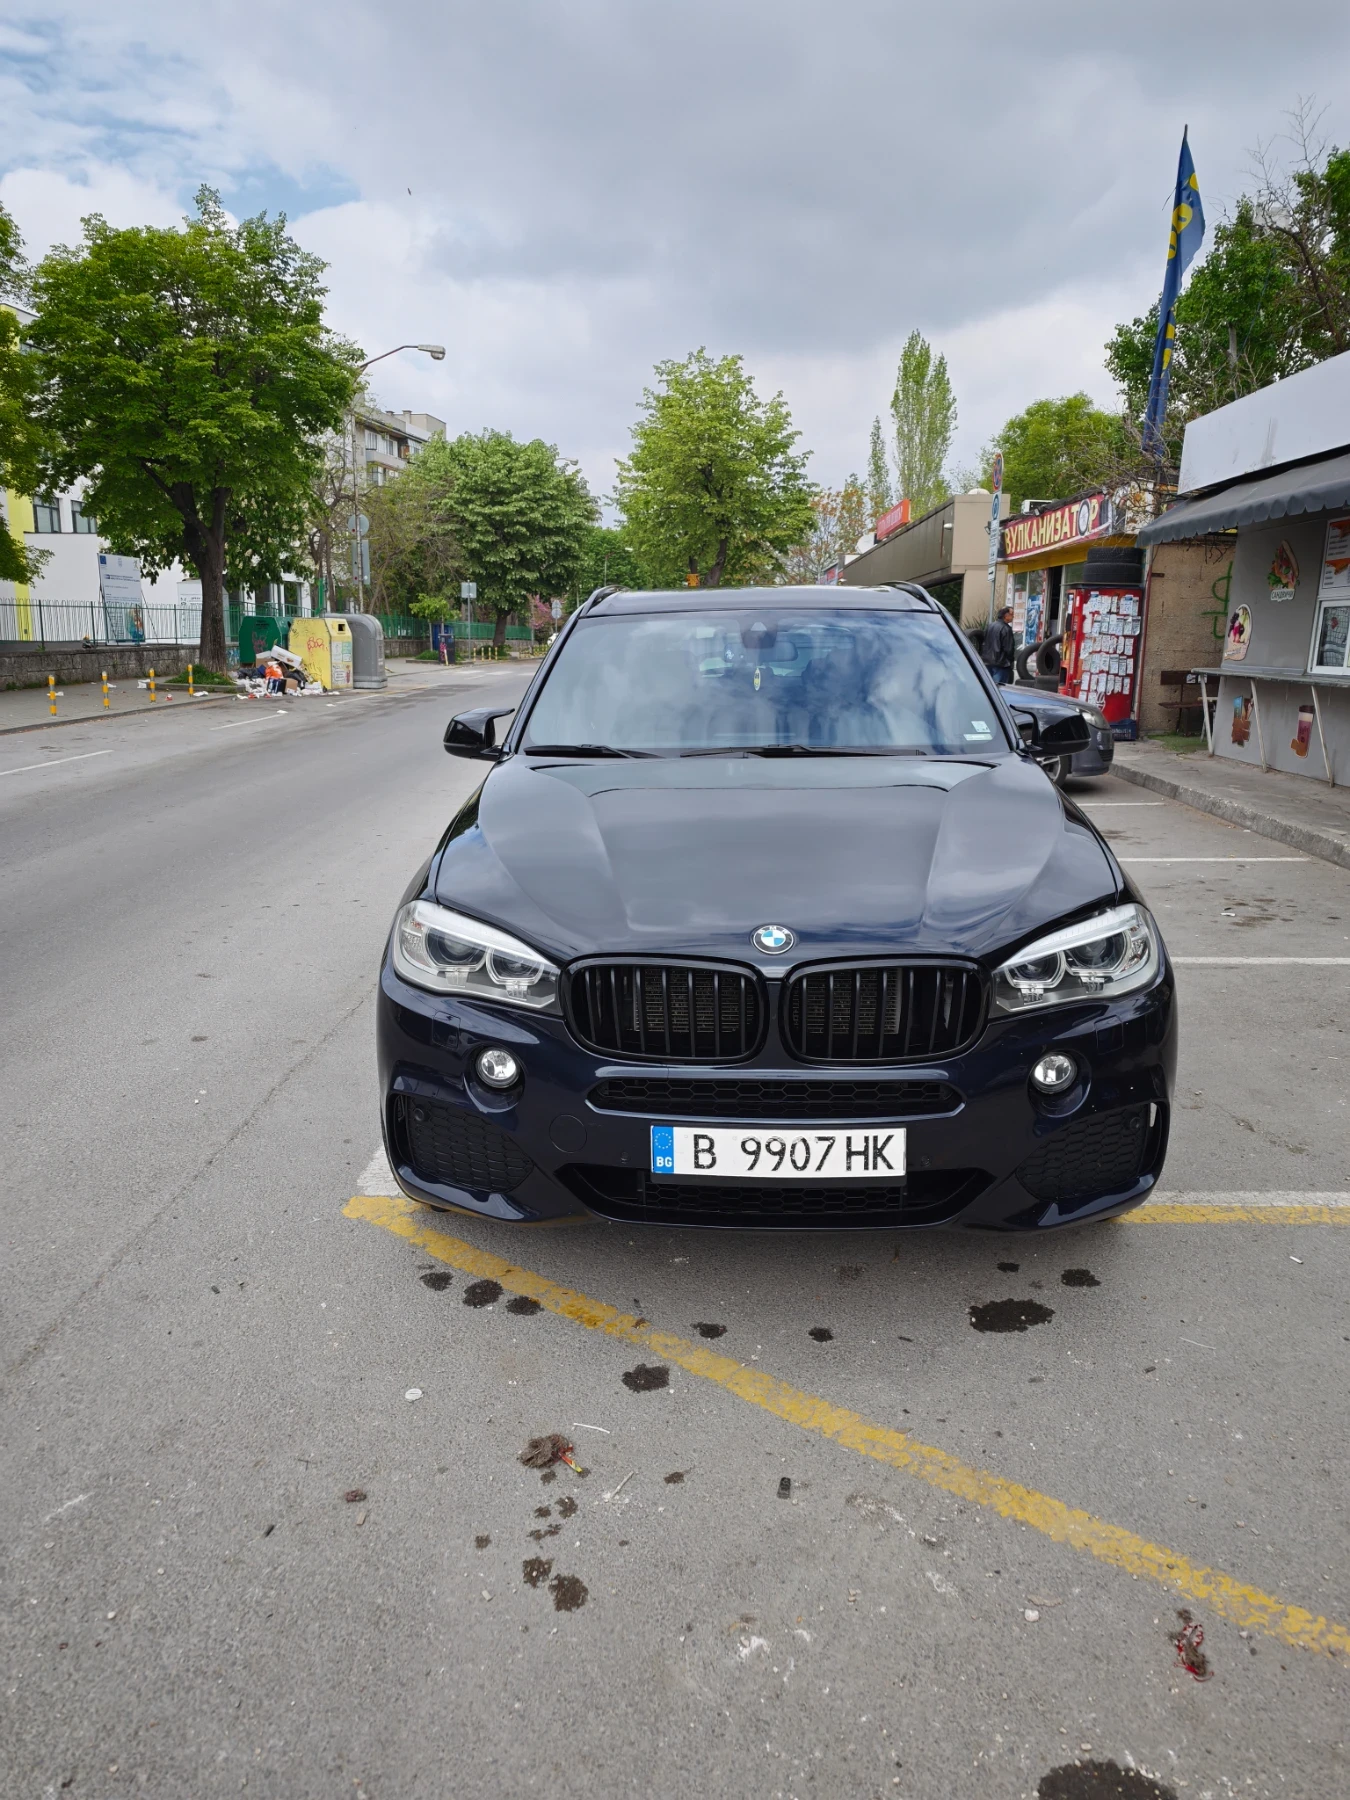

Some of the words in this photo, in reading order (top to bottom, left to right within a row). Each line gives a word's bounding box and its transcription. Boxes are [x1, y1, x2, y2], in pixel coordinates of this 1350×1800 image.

[1004, 498, 1099, 555] ВУЛКАНИЗАТОР
[656, 1156, 673, 1168] BG
[693, 1134, 717, 1169] B
[740, 1136, 836, 1172] 9907
[845, 1134, 895, 1171] HK
